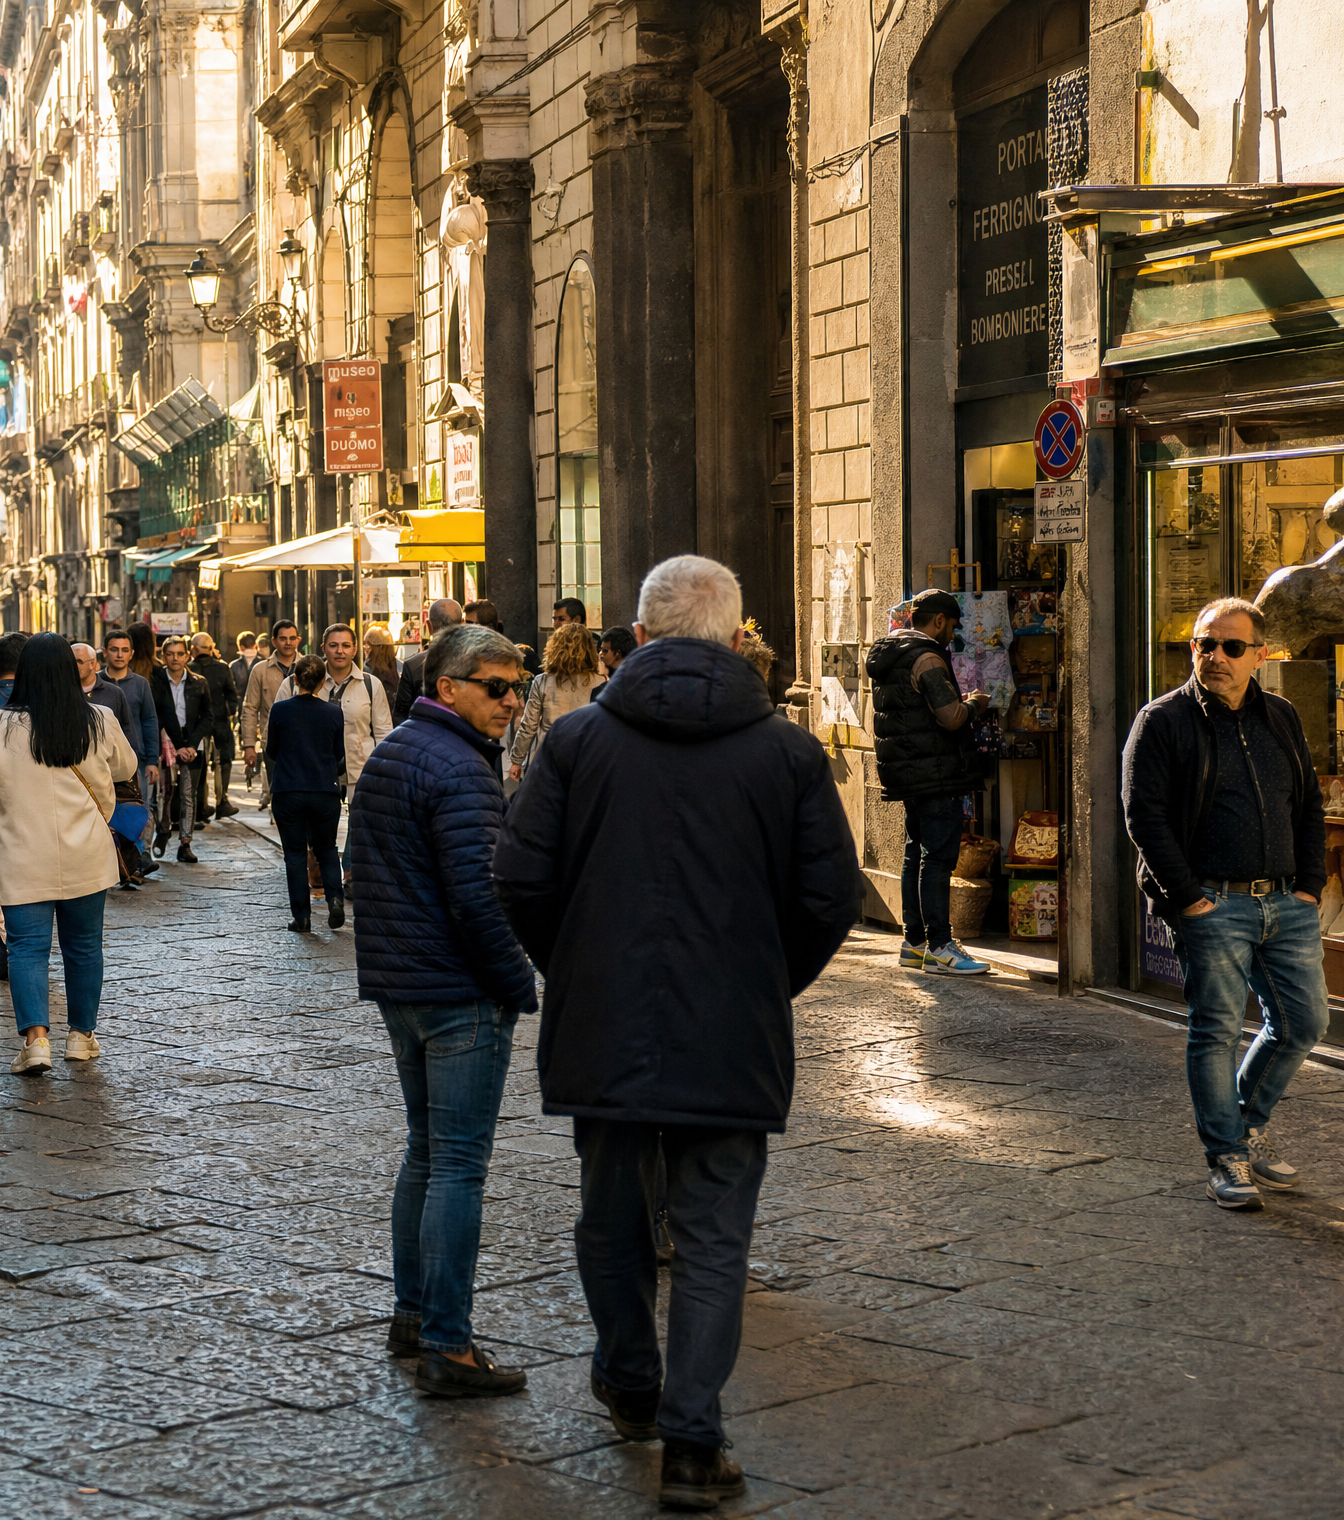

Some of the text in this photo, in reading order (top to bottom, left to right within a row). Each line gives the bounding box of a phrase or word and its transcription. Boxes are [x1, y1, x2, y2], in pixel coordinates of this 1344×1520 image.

[971, 303, 1046, 345] BOMBONIERE
[328, 365, 376, 379] museo
[331, 438, 377, 451] DUOMO
